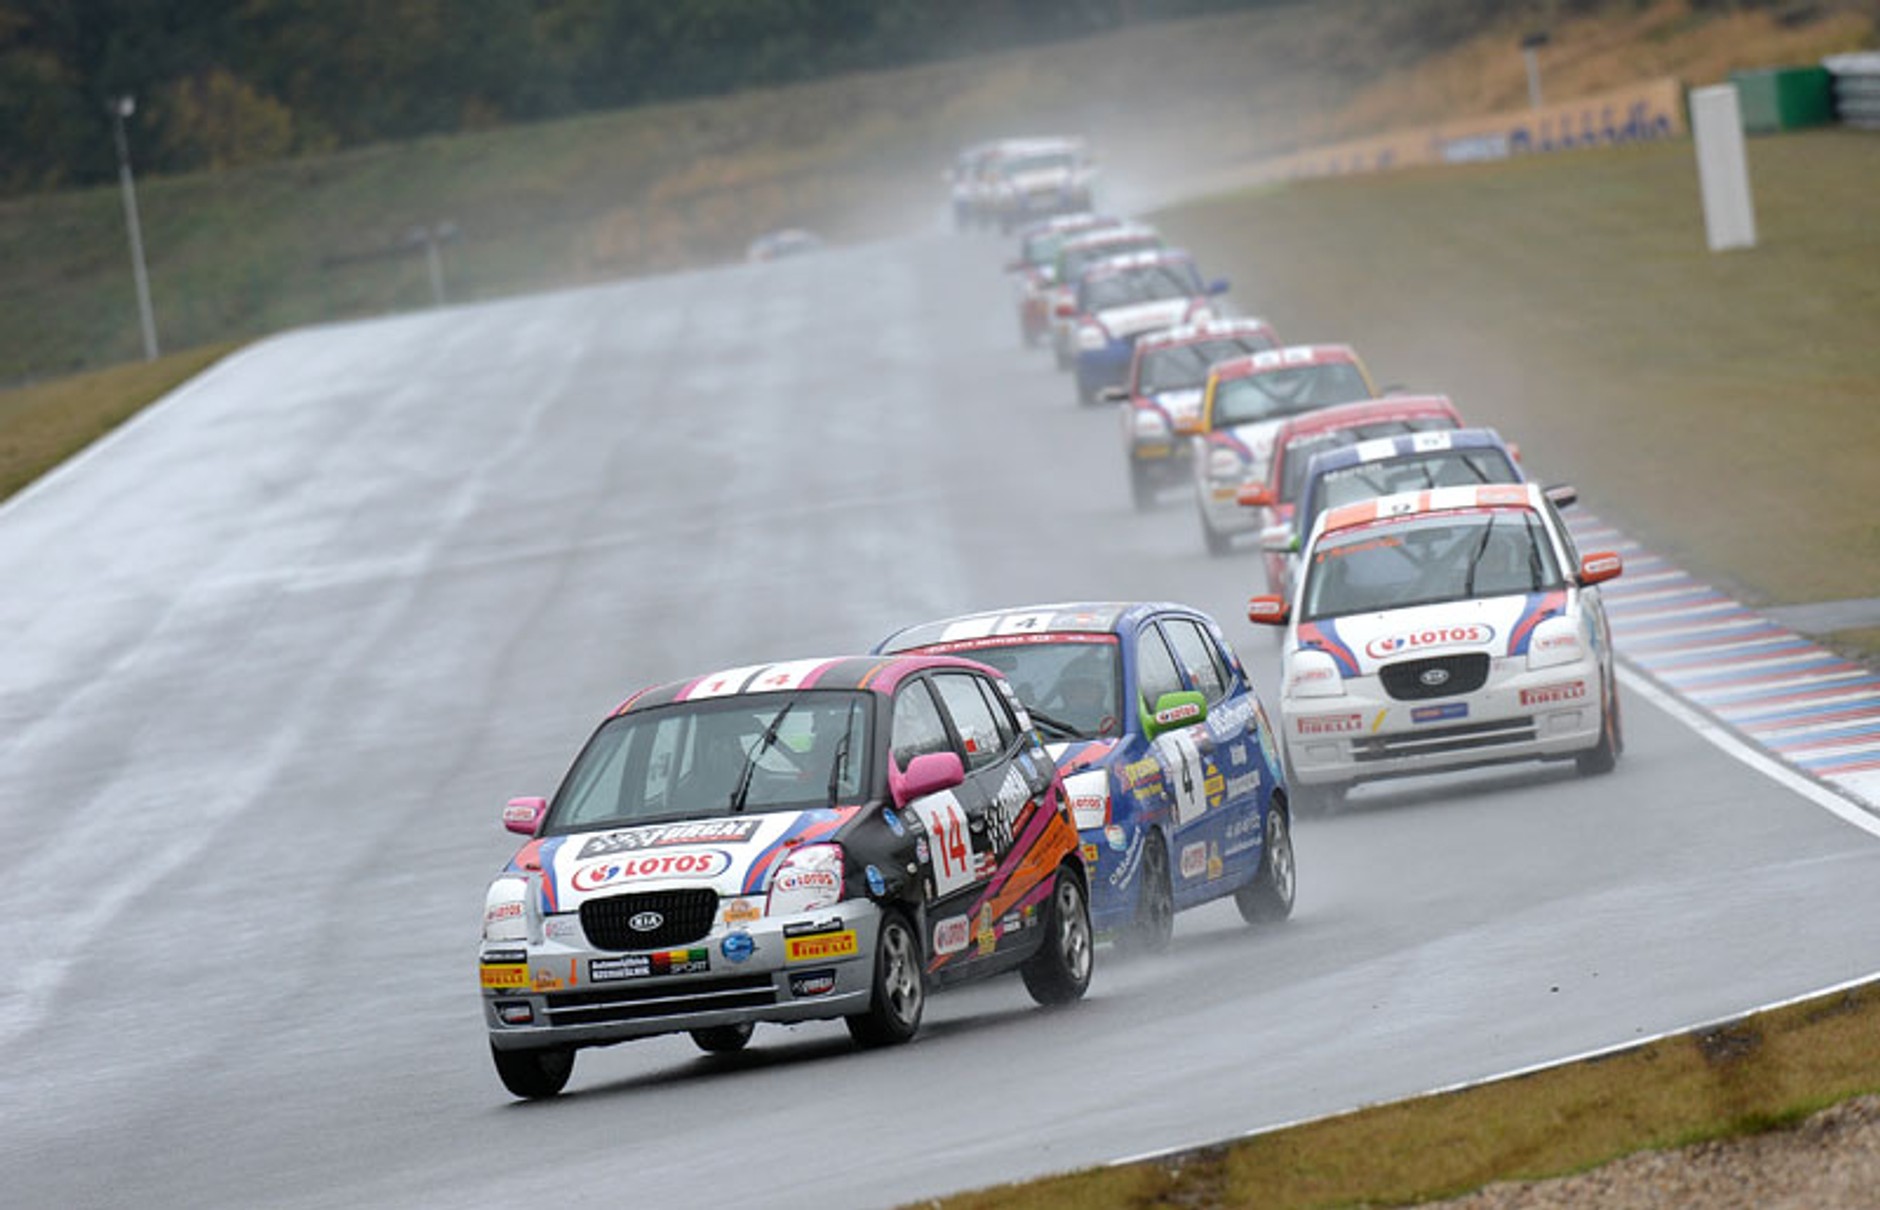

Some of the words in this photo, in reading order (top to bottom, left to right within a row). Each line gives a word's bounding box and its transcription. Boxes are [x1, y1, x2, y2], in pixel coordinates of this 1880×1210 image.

[1409, 627, 1479, 646] LOTOS
[1519, 681, 1585, 705] PIRELLI
[1297, 714, 1362, 733] PIRELLI
[1174, 740, 1195, 805] 4
[931, 805, 967, 878] 14
[624, 855, 713, 877] LOTOS
[798, 873, 833, 885] LOTOS
[634, 914, 658, 927] KIA
[792, 935, 852, 957] PIRELLI
[670, 961, 706, 974] SPORT
